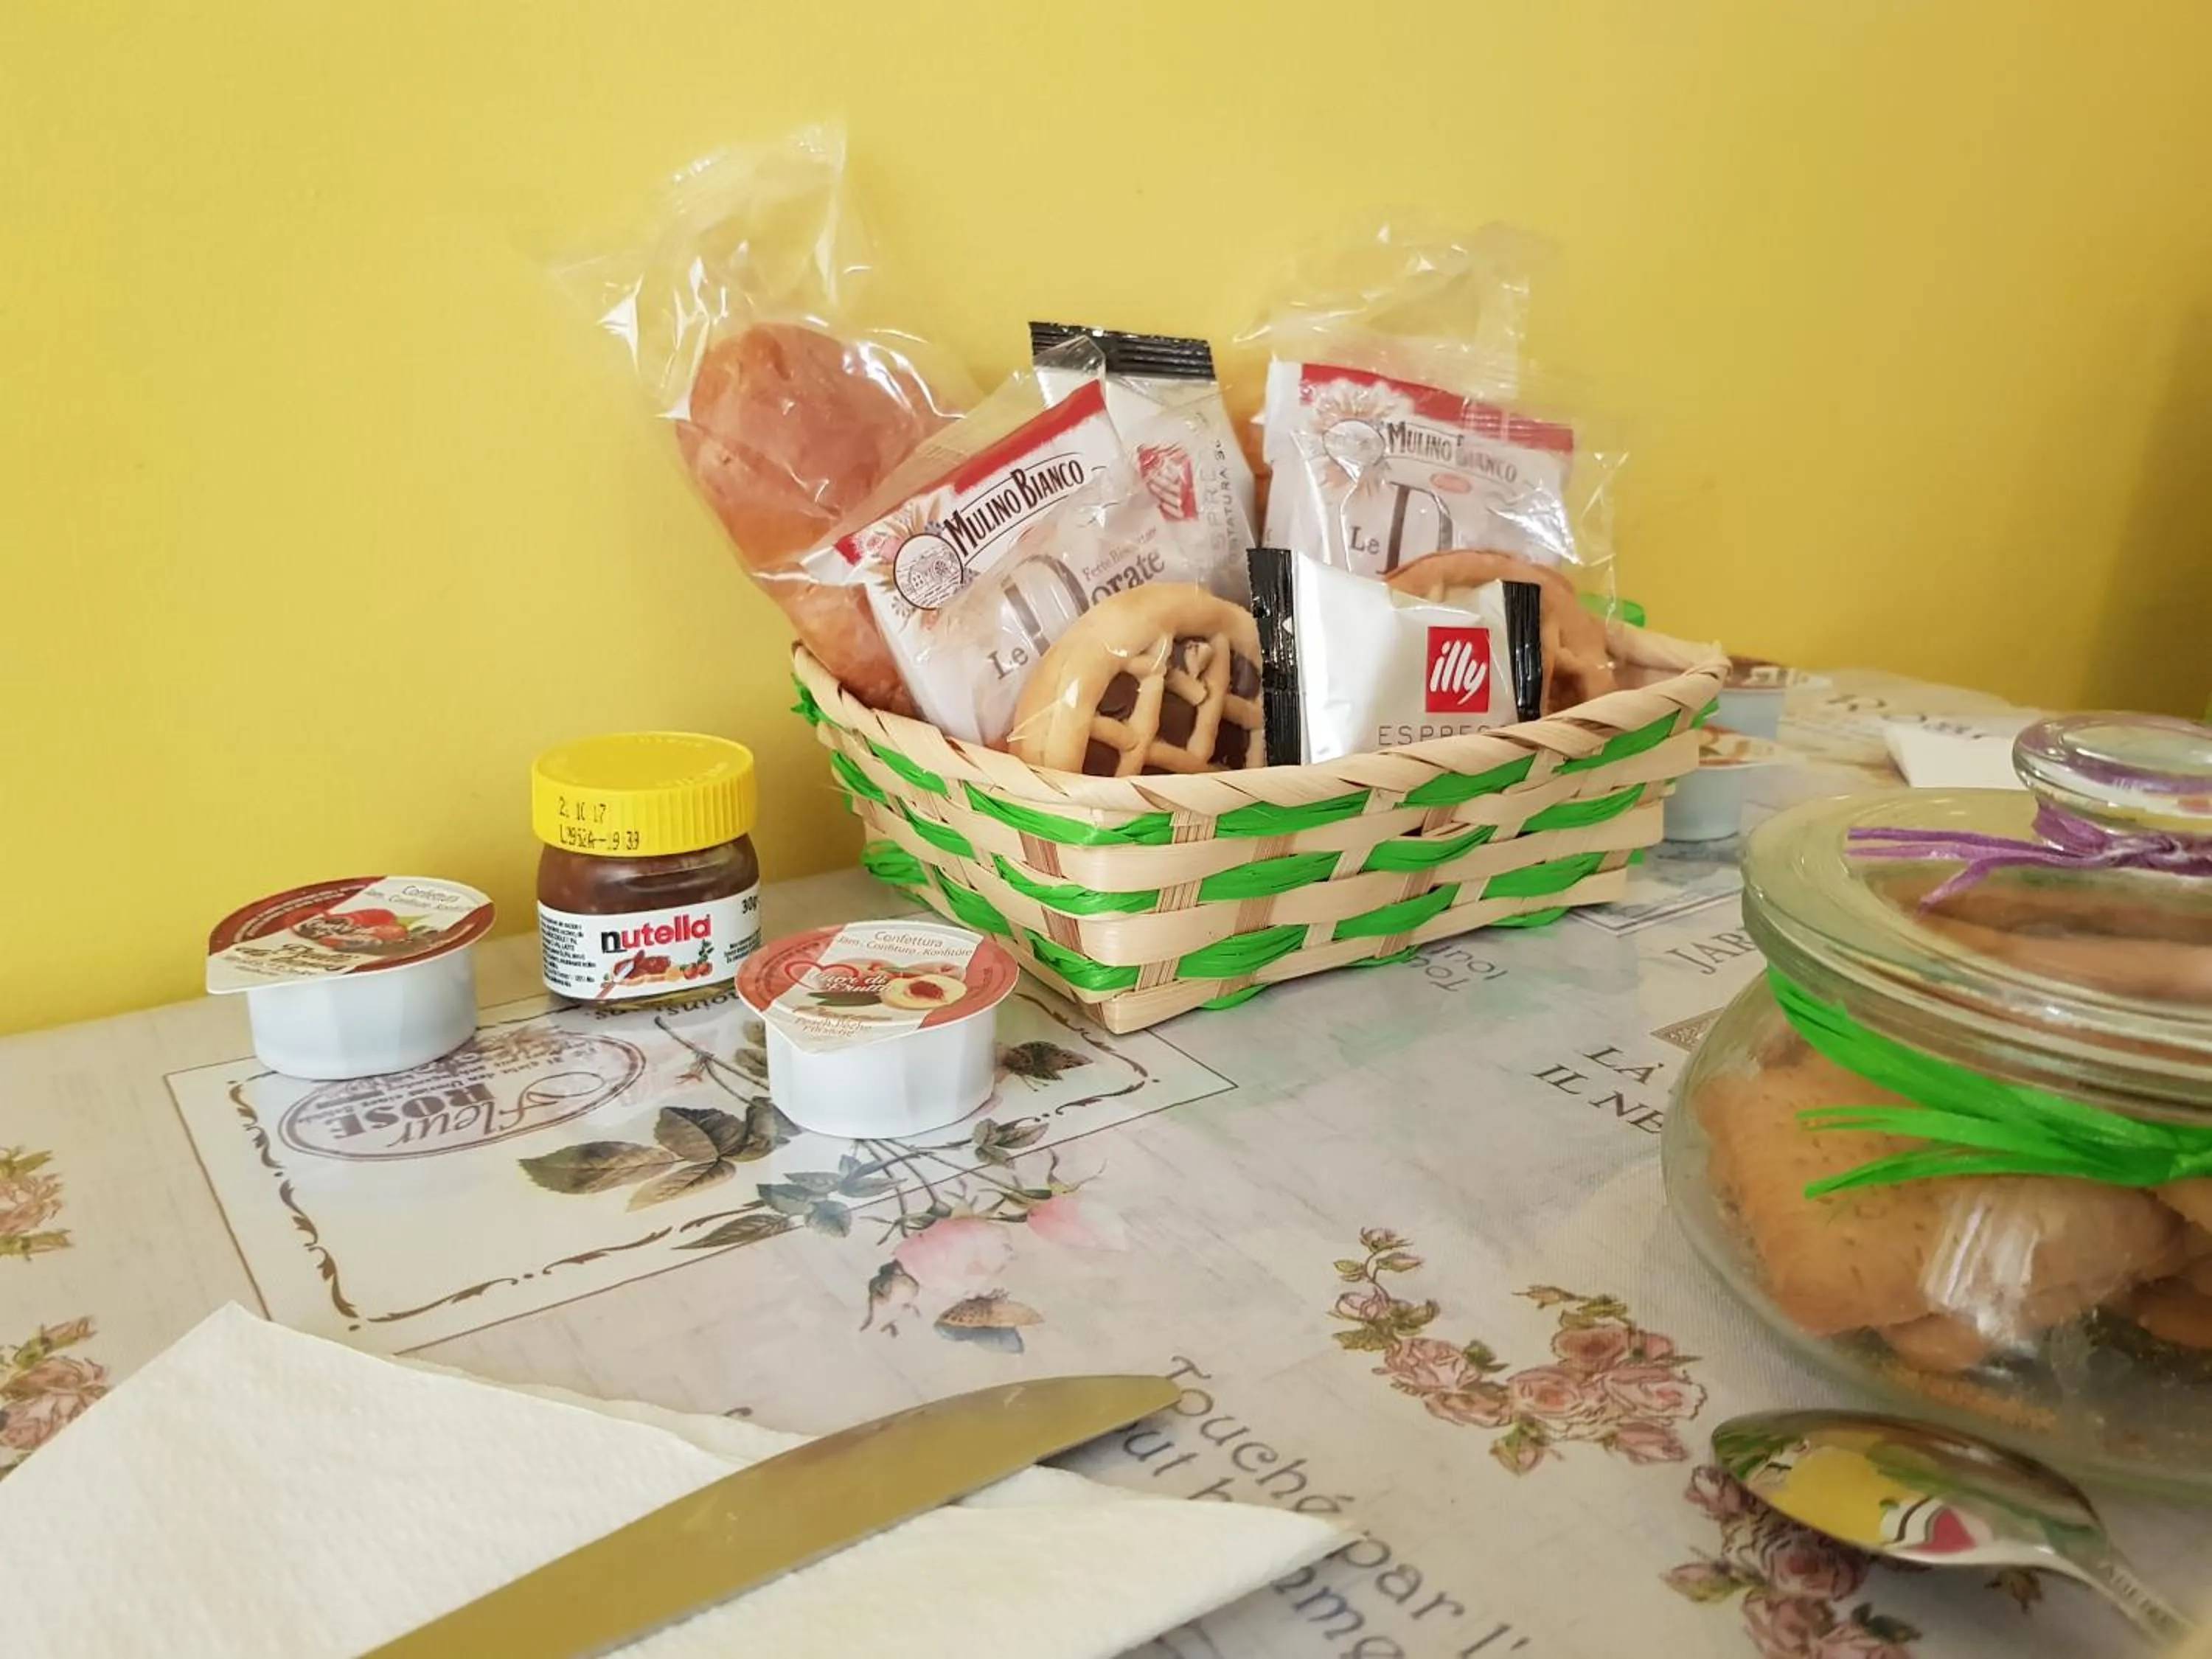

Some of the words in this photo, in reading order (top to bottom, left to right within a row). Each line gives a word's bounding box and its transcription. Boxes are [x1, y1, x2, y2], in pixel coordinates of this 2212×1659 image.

[1387, 422, 1452, 462] MULINO
[944, 490, 1021, 559] MULINO
[1011, 459, 1085, 509] BIANCO
[1351, 525, 1380, 554] Le
[987, 646, 1029, 681] Le
[1429, 639, 1488, 706] illy
[601, 914, 711, 953] nutella
[874, 931, 945, 948] Confettura
[1663, 928, 1757, 975] JAR
[1531, 1064, 1588, 1095] IL
[324, 1082, 497, 1140] ROSE
